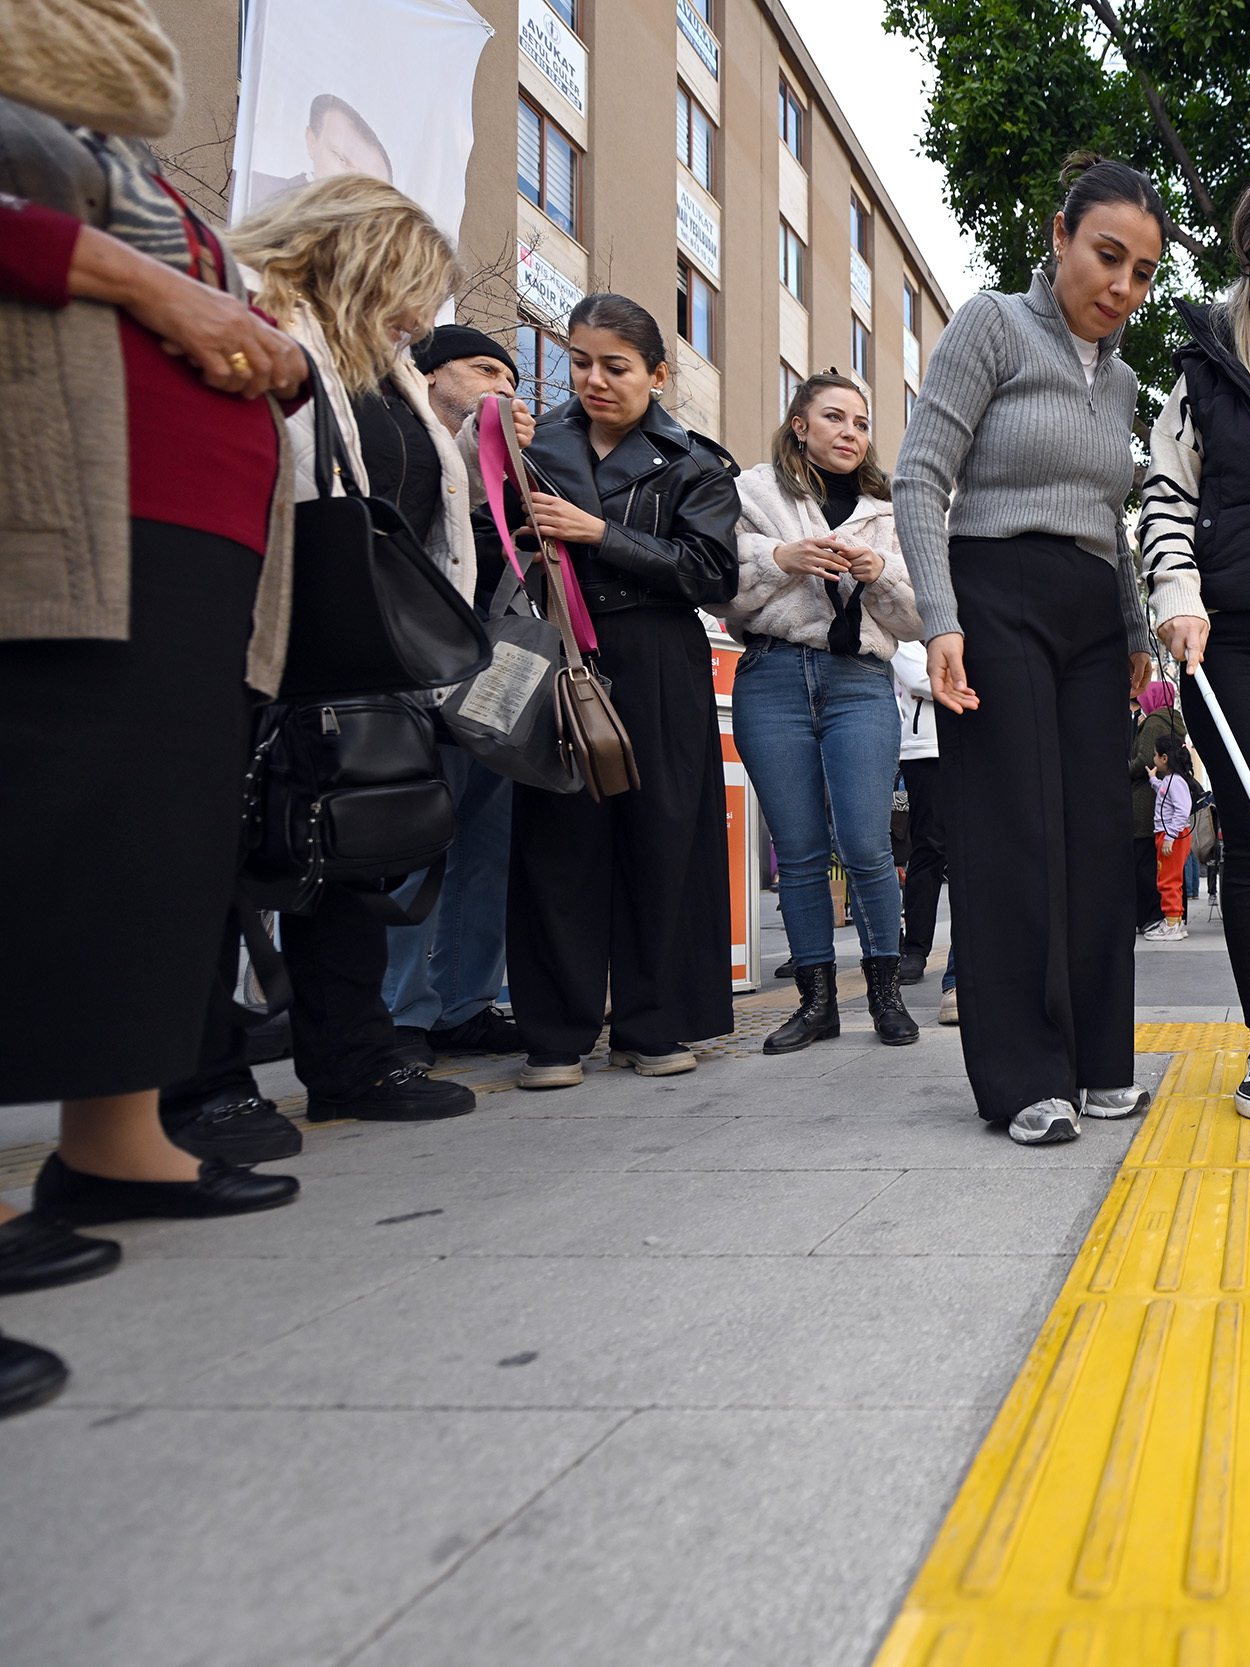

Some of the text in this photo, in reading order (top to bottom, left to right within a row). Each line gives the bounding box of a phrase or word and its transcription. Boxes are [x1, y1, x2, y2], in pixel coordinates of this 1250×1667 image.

[522, 25, 550, 63] BETÜL
[552, 61, 580, 97] GÜLER
[527, 18, 576, 78] AVUKAT
[680, 191, 714, 237] AVUKAT
[524, 269, 557, 306] KADİR
